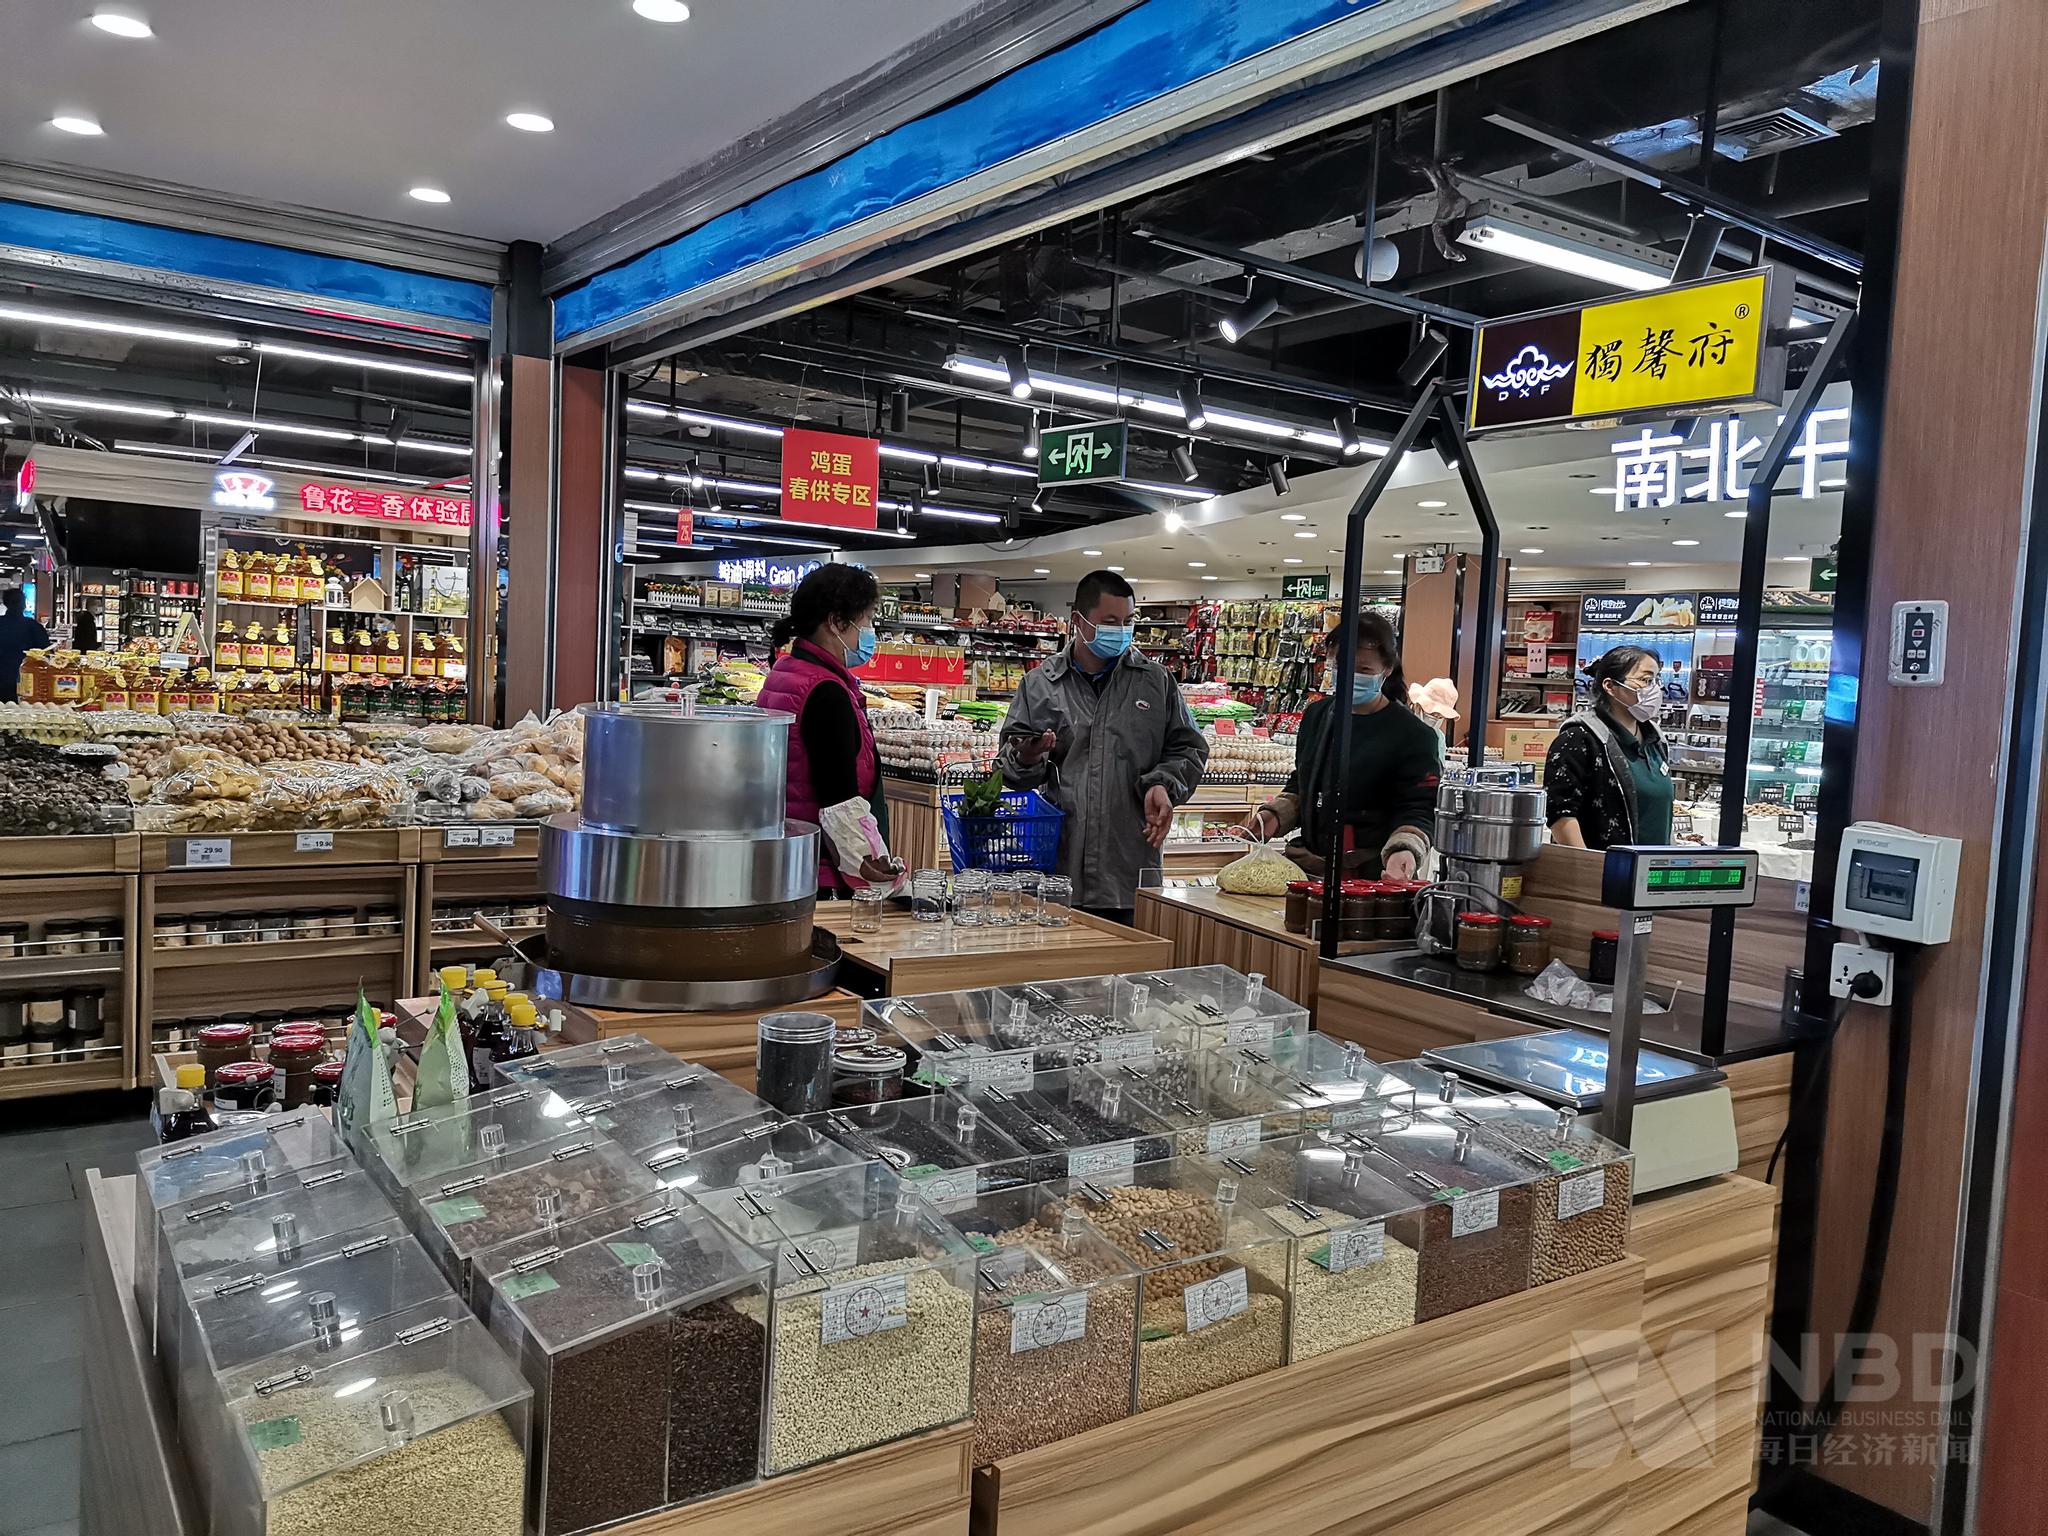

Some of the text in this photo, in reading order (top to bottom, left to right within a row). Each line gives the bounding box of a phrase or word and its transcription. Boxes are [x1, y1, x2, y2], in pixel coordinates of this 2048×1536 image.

[1585, 321, 1735, 383] 獨馨府
[1498, 384, 1551, 401] DXF
[810, 450, 852, 476] 鸡蛋
[789, 477, 872, 507] 春供专区
[769, 565, 795, 586] Grain
[315, 840, 332, 848] 19.90
